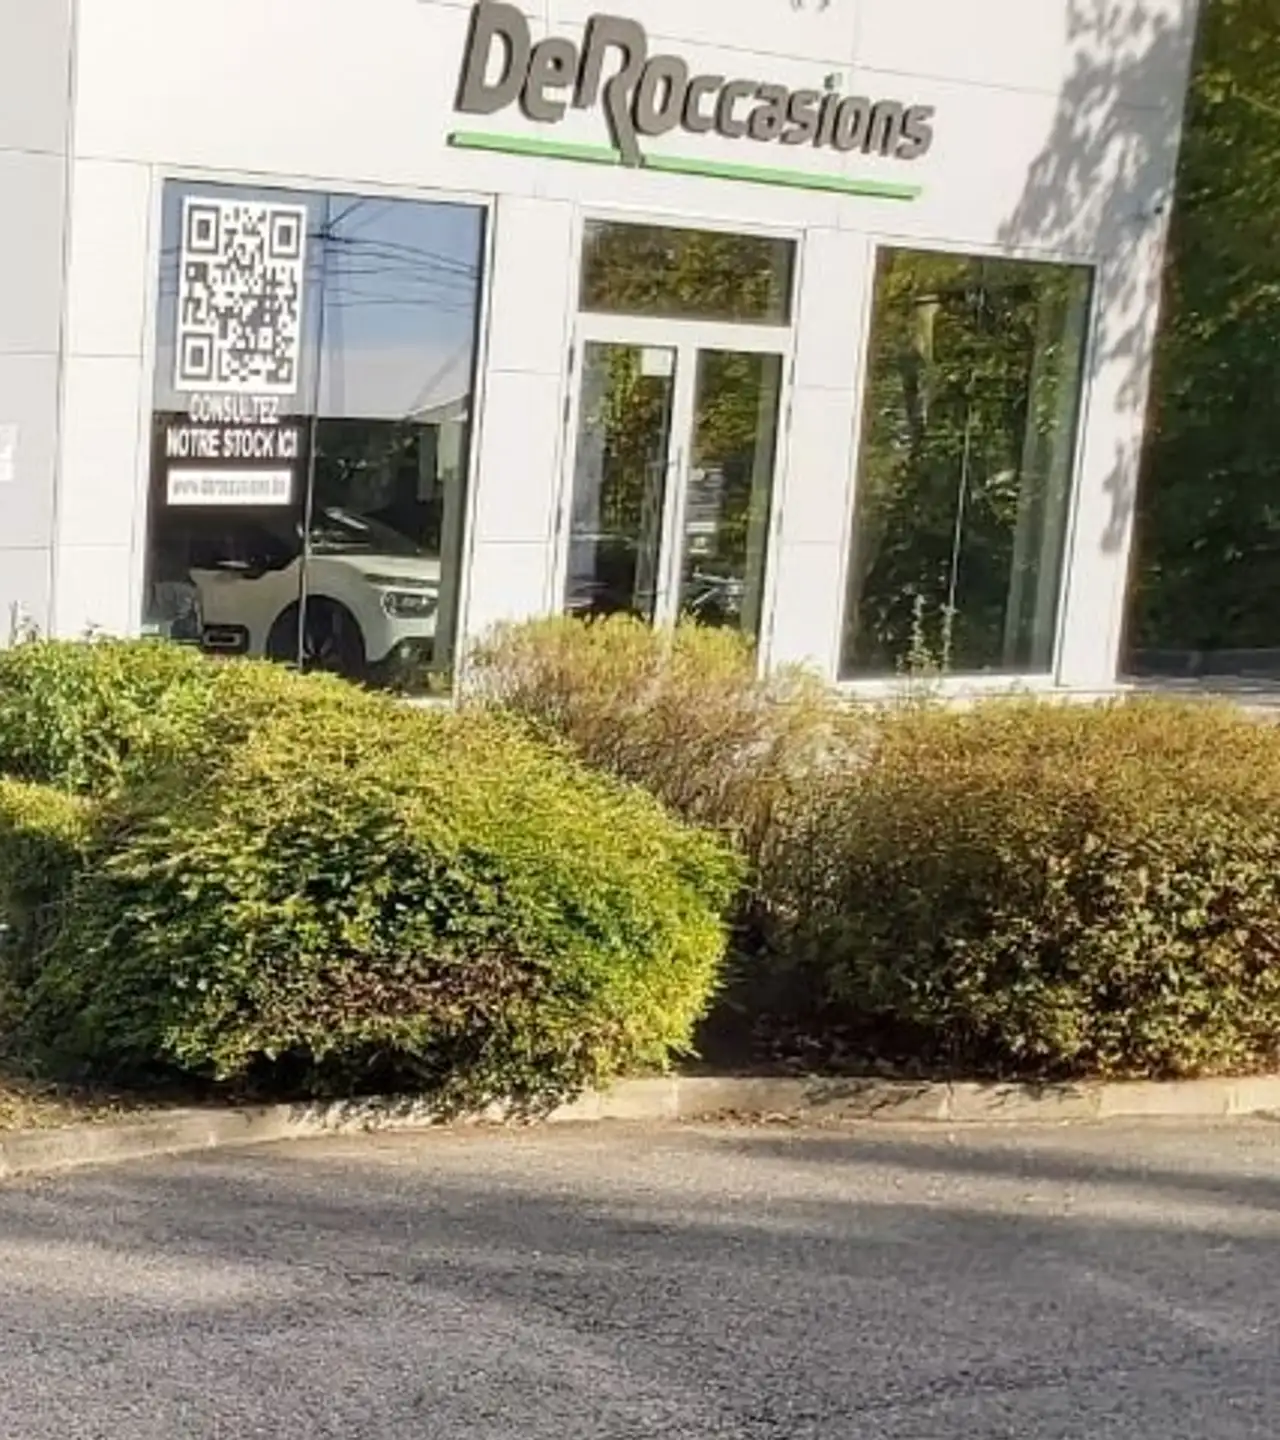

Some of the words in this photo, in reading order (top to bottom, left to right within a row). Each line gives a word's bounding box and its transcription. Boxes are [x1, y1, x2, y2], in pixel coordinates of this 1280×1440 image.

[189, 394, 279, 424] CONSULTEZ
[166, 427, 220, 457] NOTRE
[223, 428, 274, 458] STOCK
[278, 428, 298, 458] ICI
